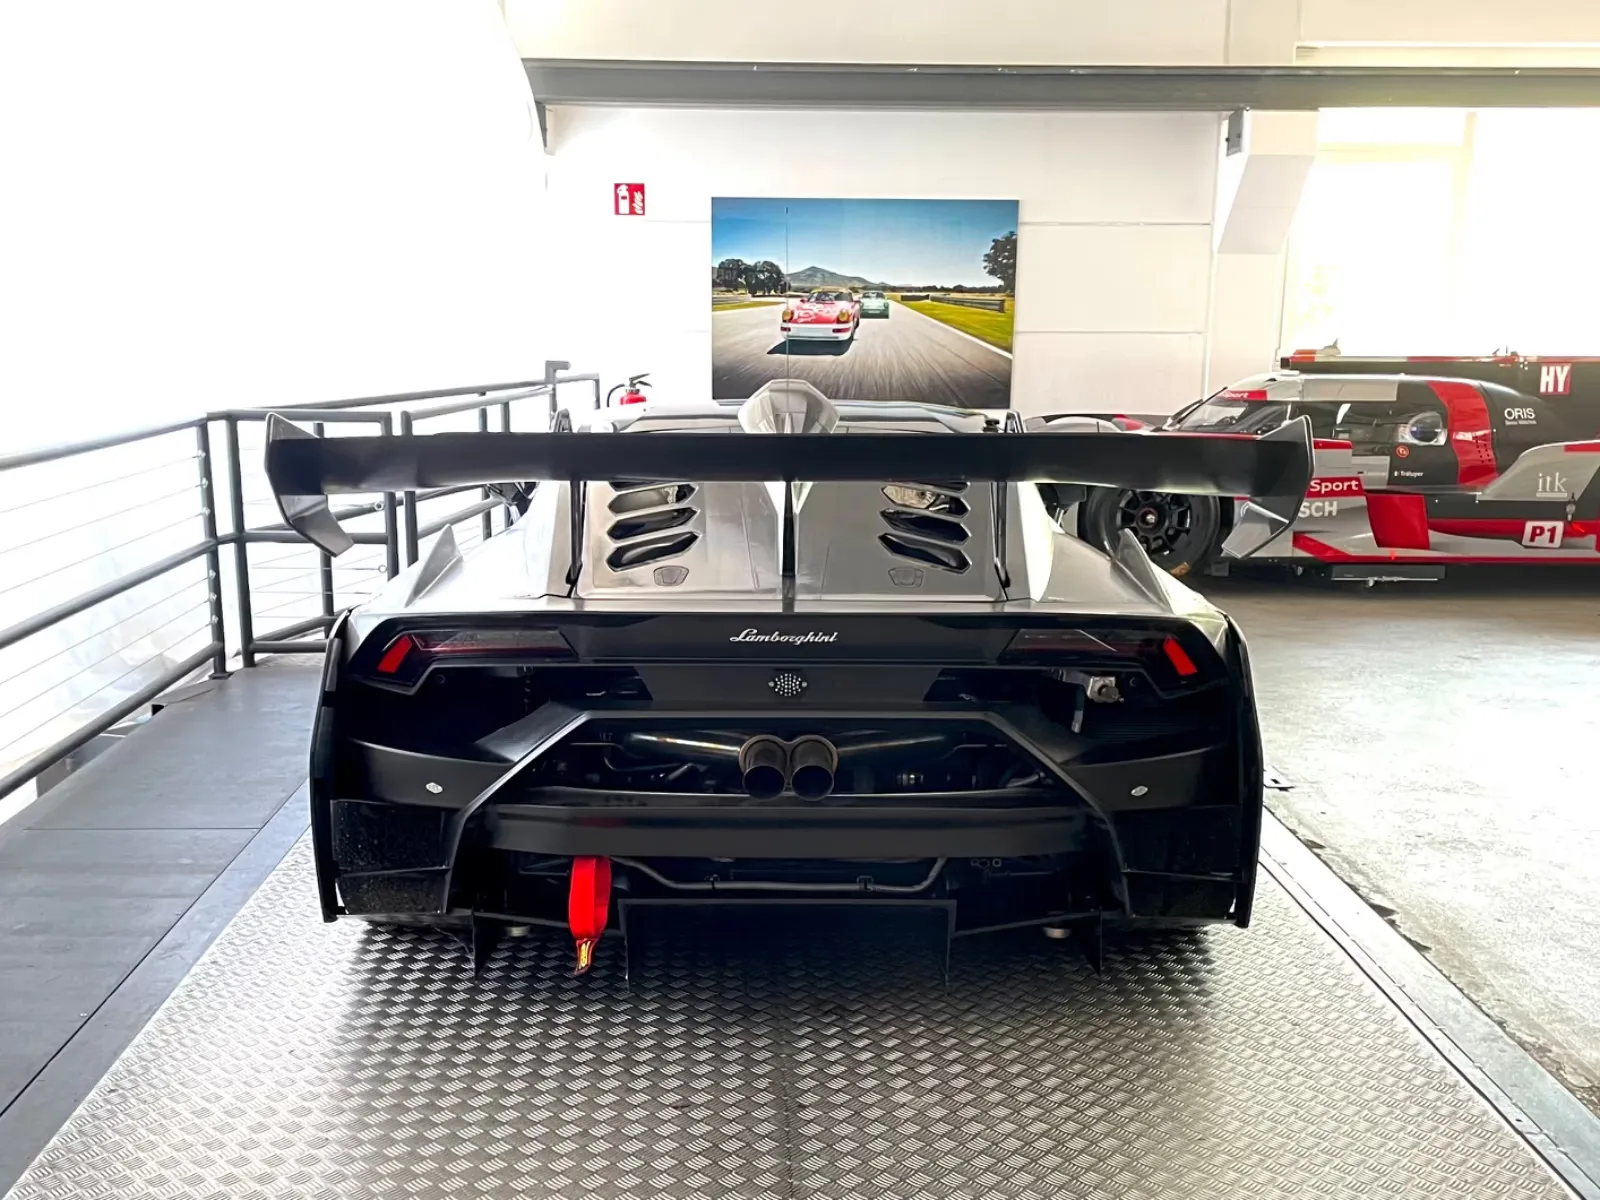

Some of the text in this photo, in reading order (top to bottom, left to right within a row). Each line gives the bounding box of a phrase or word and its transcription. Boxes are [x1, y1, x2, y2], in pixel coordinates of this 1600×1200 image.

[1540, 365, 1571, 393] HY
[1504, 407, 1536, 420] ORIS
[1309, 479, 1359, 494] Sport
[1537, 472, 1567, 492] itk
[1298, 501, 1338, 518] SCH
[1528, 525, 1558, 544] P1
[729, 628, 839, 646] Lamborghini
